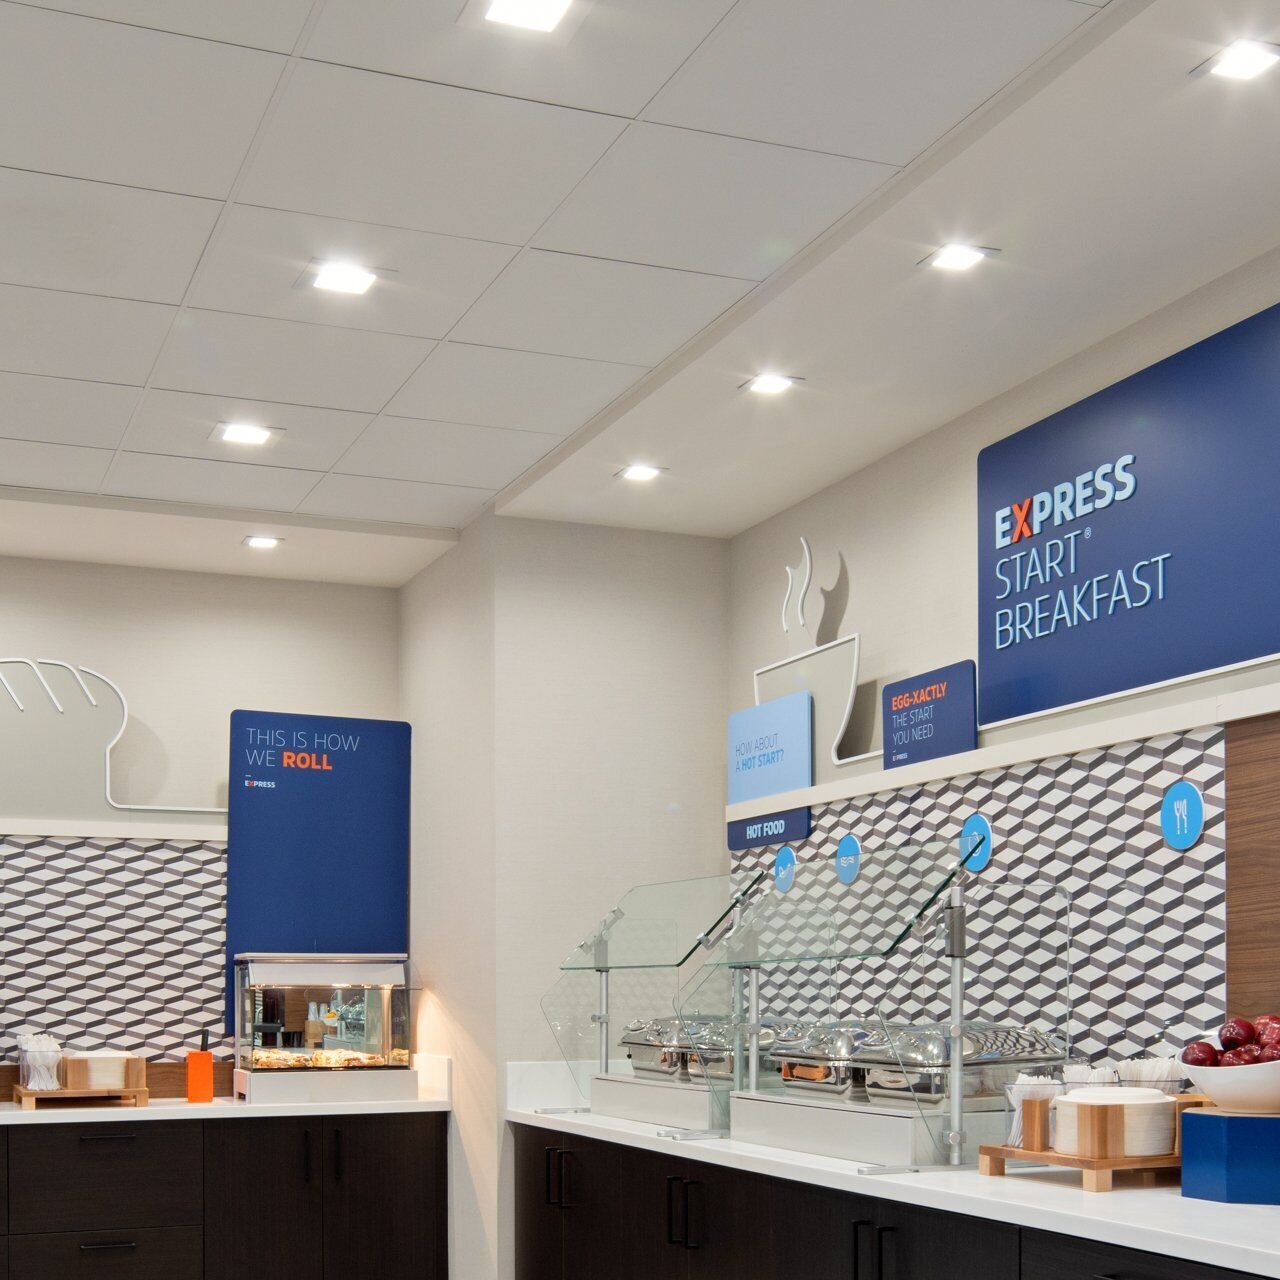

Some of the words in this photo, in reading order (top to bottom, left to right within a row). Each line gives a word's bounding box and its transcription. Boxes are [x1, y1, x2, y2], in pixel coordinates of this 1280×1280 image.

[995, 454, 1137, 550] EXPRESS
[995, 552, 1172, 650] BREAKFAST
[892, 681, 947, 711] EGG-XACTLY
[892, 713, 907, 729] THE
[909, 704, 934, 725] START
[246, 727, 286, 747] THIS
[293, 731, 308, 749] IS
[314, 732, 360, 752] HOW
[735, 742, 753, 757] HOW
[754, 732, 779, 752] ABOUT
[892, 731, 910, 746] YOU
[911, 723, 934, 740] NEED
[245, 749, 276, 767] WE
[282, 751, 333, 770] ROLL
[735, 761, 740, 772] A
[741, 756, 756, 770] HOT
[758, 748, 785, 768] START?
[244, 780, 276, 788] EXPRESS
[746, 825, 762, 839] HOT
[763, 819, 785, 836] FOOD
